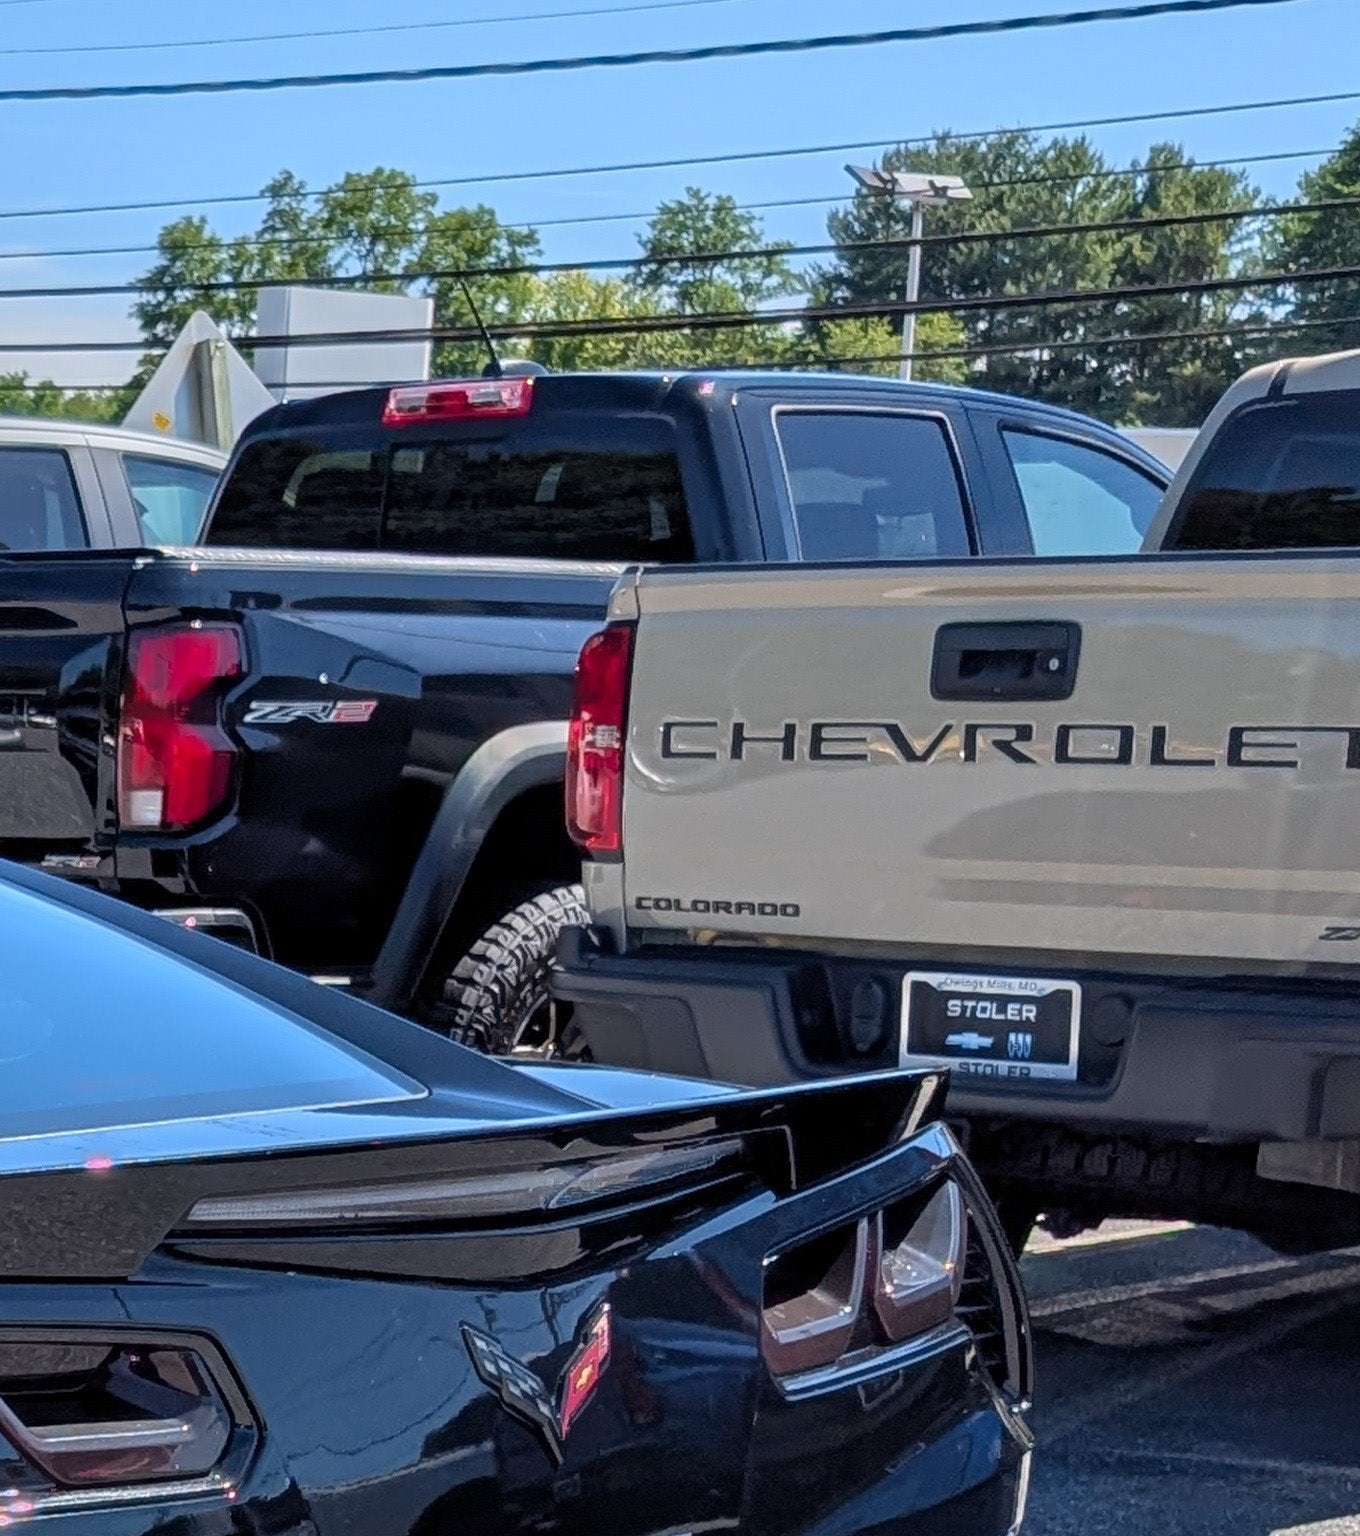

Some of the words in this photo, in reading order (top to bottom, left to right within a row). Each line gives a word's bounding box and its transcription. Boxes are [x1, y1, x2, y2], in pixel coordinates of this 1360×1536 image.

[242, 700, 378, 724] ZR2
[660, 720, 1360, 769] CHEVROLET
[635, 896, 800, 918] COLORADO
[1018, 980, 1038, 992] MD
[946, 999, 1038, 1023] STOLER
[958, 1061, 1031, 1078] STOLER
